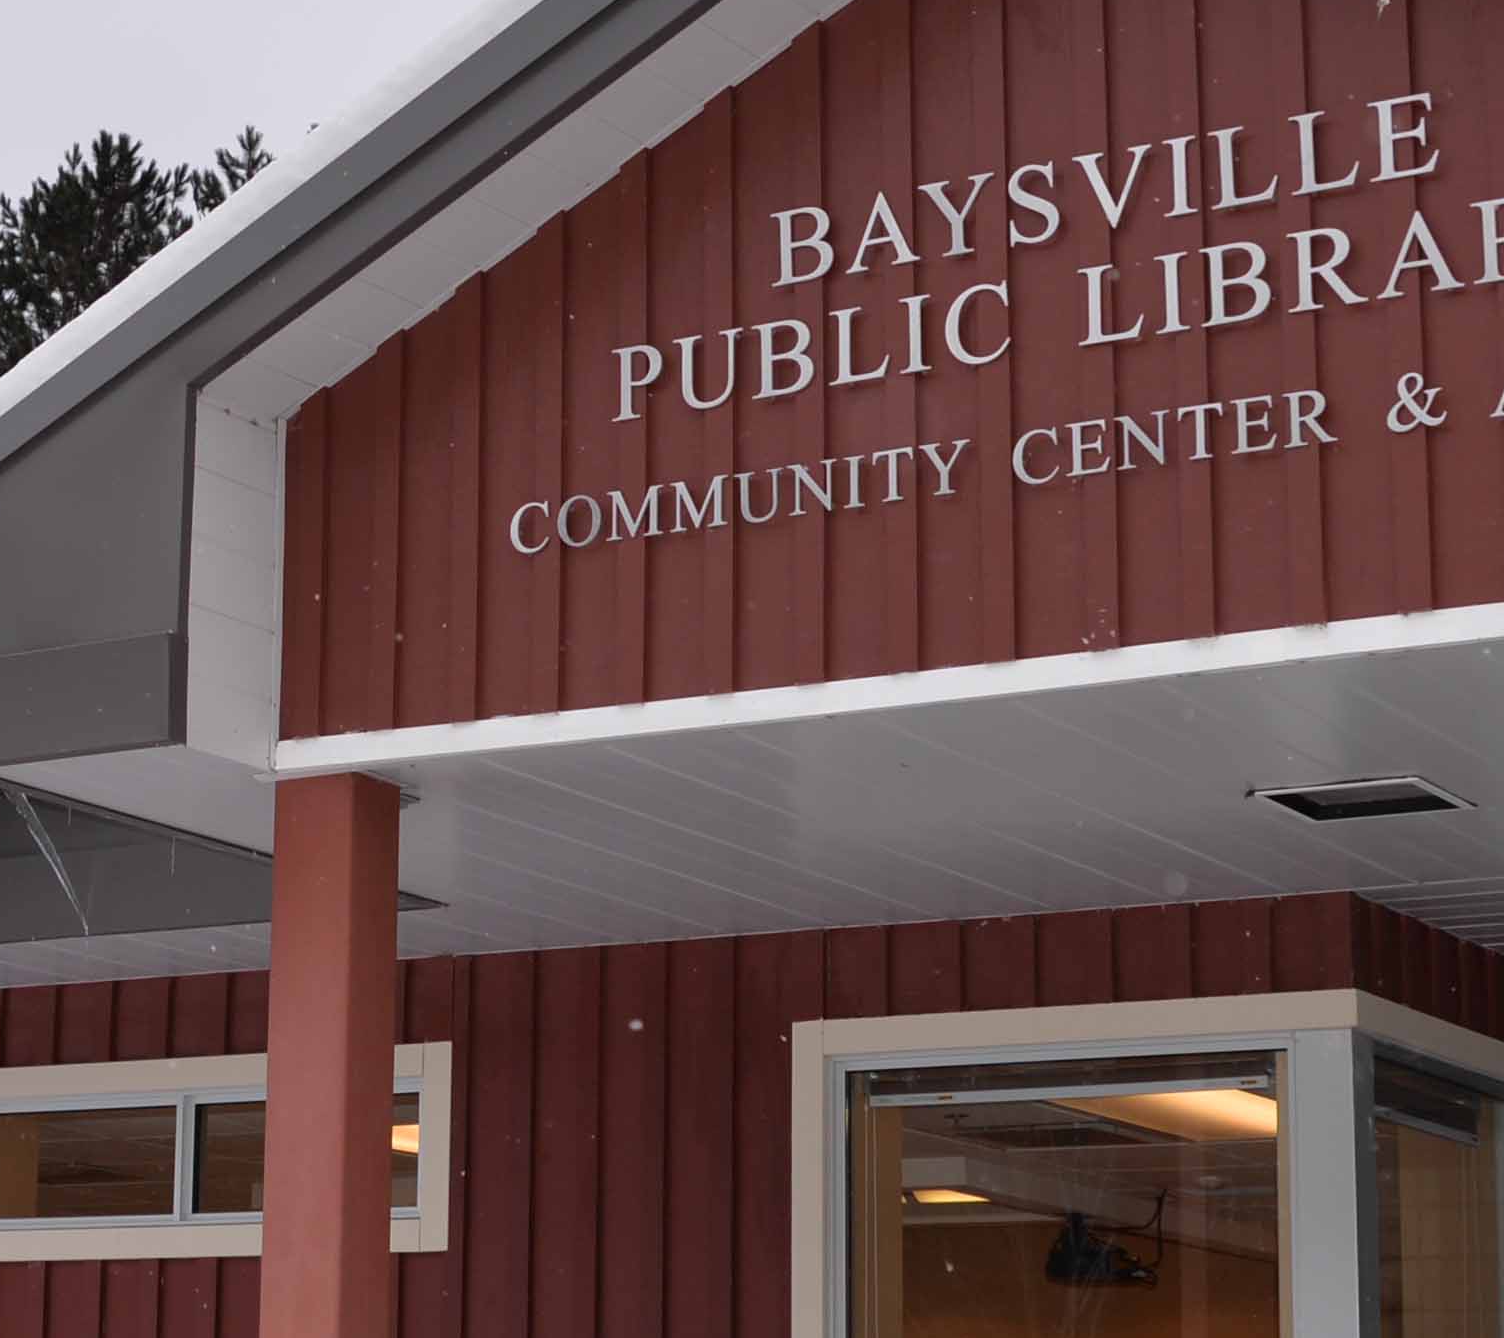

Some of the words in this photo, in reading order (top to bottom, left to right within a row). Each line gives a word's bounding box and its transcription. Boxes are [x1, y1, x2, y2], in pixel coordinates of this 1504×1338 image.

[769, 92, 1440, 288] BAYSVILLE
[611, 279, 1011, 422] PUBLIC
[509, 438, 971, 554] COMMUNITY
[1012, 389, 1339, 485] CENTER
[1387, 372, 1447, 433] &
